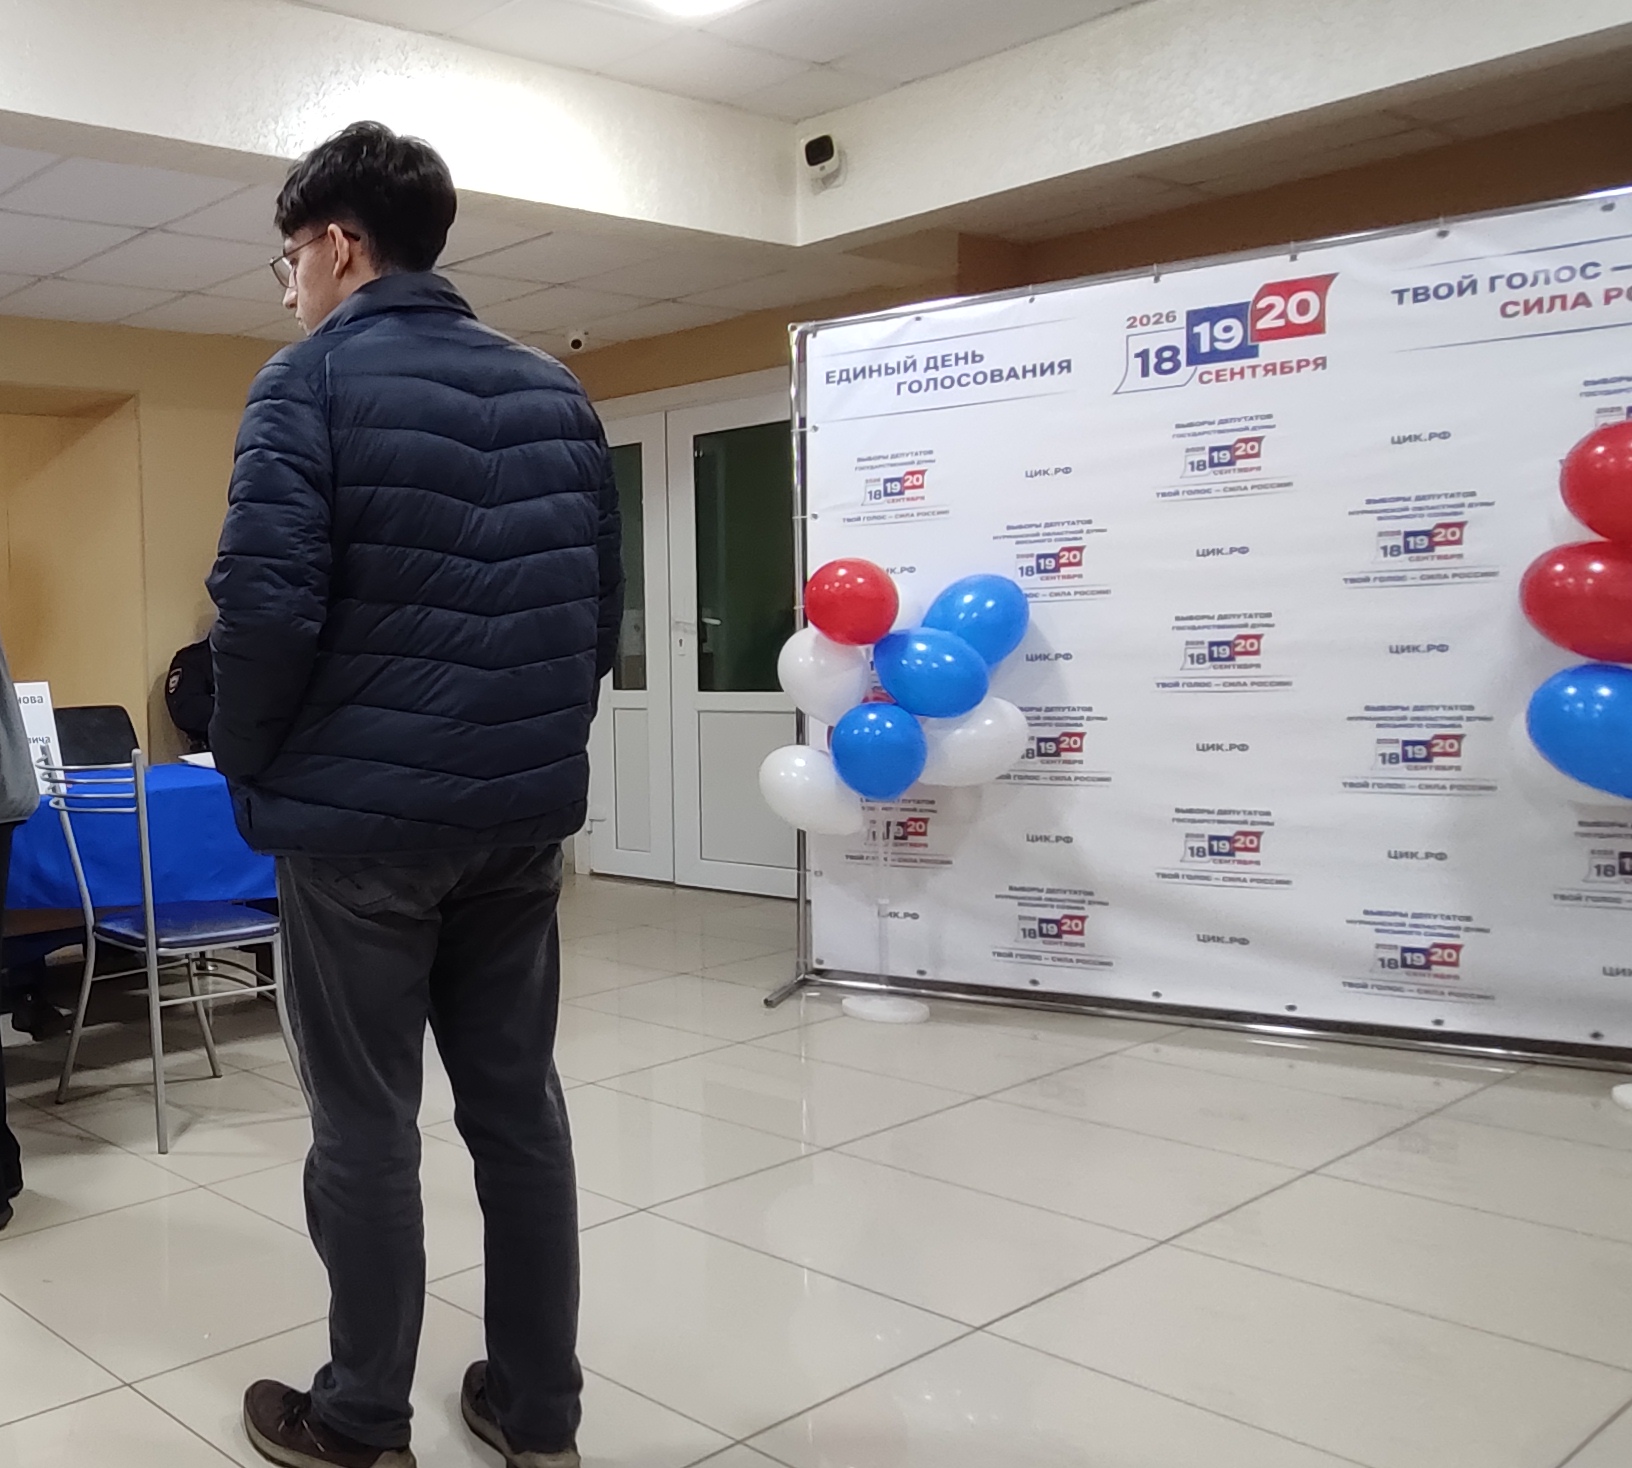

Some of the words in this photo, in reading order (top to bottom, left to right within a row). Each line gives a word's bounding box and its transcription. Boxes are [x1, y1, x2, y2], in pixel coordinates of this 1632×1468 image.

[1391, 274, 1478, 305] ТВОЙ
[1489, 261, 1603, 293] ГОЛОС
[1255, 290, 1320, 330] 20
[1500, 292, 1593, 319] СИЛА
[1126, 311, 1177, 329] 2026
[1193, 318, 1244, 354] 19
[825, 355, 917, 385] ЕДИНЫЙ
[923, 350, 985, 373] ДЕНЬ
[1134, 345, 1181, 378] 18
[896, 359, 1072, 395] ГОЛОСОВАНИЯ
[1198, 356, 1327, 385] СЕНТЯБРЯ
[1391, 431, 1451, 445] ЦИК.РФ
[1235, 442, 1259, 456] 20
[1211, 450, 1230, 464] 19
[1025, 466, 1072, 478] ЦИК.РФ
[1188, 460, 1207, 472] 18
[885, 481, 900, 493] 19
[903, 474, 923, 487] 20
[868, 489, 882, 501] 18
[1058, 550, 1080, 564] 20
[1196, 546, 1250, 558] ЦИК.РФ
[1038, 558, 1056, 570] 19
[1018, 565, 1035, 578] 18
[1211, 645, 1230, 658] 19
[1234, 639, 1259, 652] 20
[1389, 644, 1449, 655] ЦИК.РФ
[1025, 653, 1073, 662] ЦИК.РФ
[1188, 653, 1207, 665] 18
[1039, 742, 1057, 754] 19
[1059, 736, 1081, 748] 20
[1196, 743, 1250, 752] ЦИК.РФ
[907, 821, 925, 832] 20
[1026, 834, 1074, 844] ЦИК.РФ
[1234, 835, 1258, 849] 20
[1188, 846, 1207, 858] 18
[1211, 840, 1230, 853] 19
[1388, 850, 1448, 861] ЦИК.РФ
[1196, 934, 1250, 946] ЦИК.РФ
